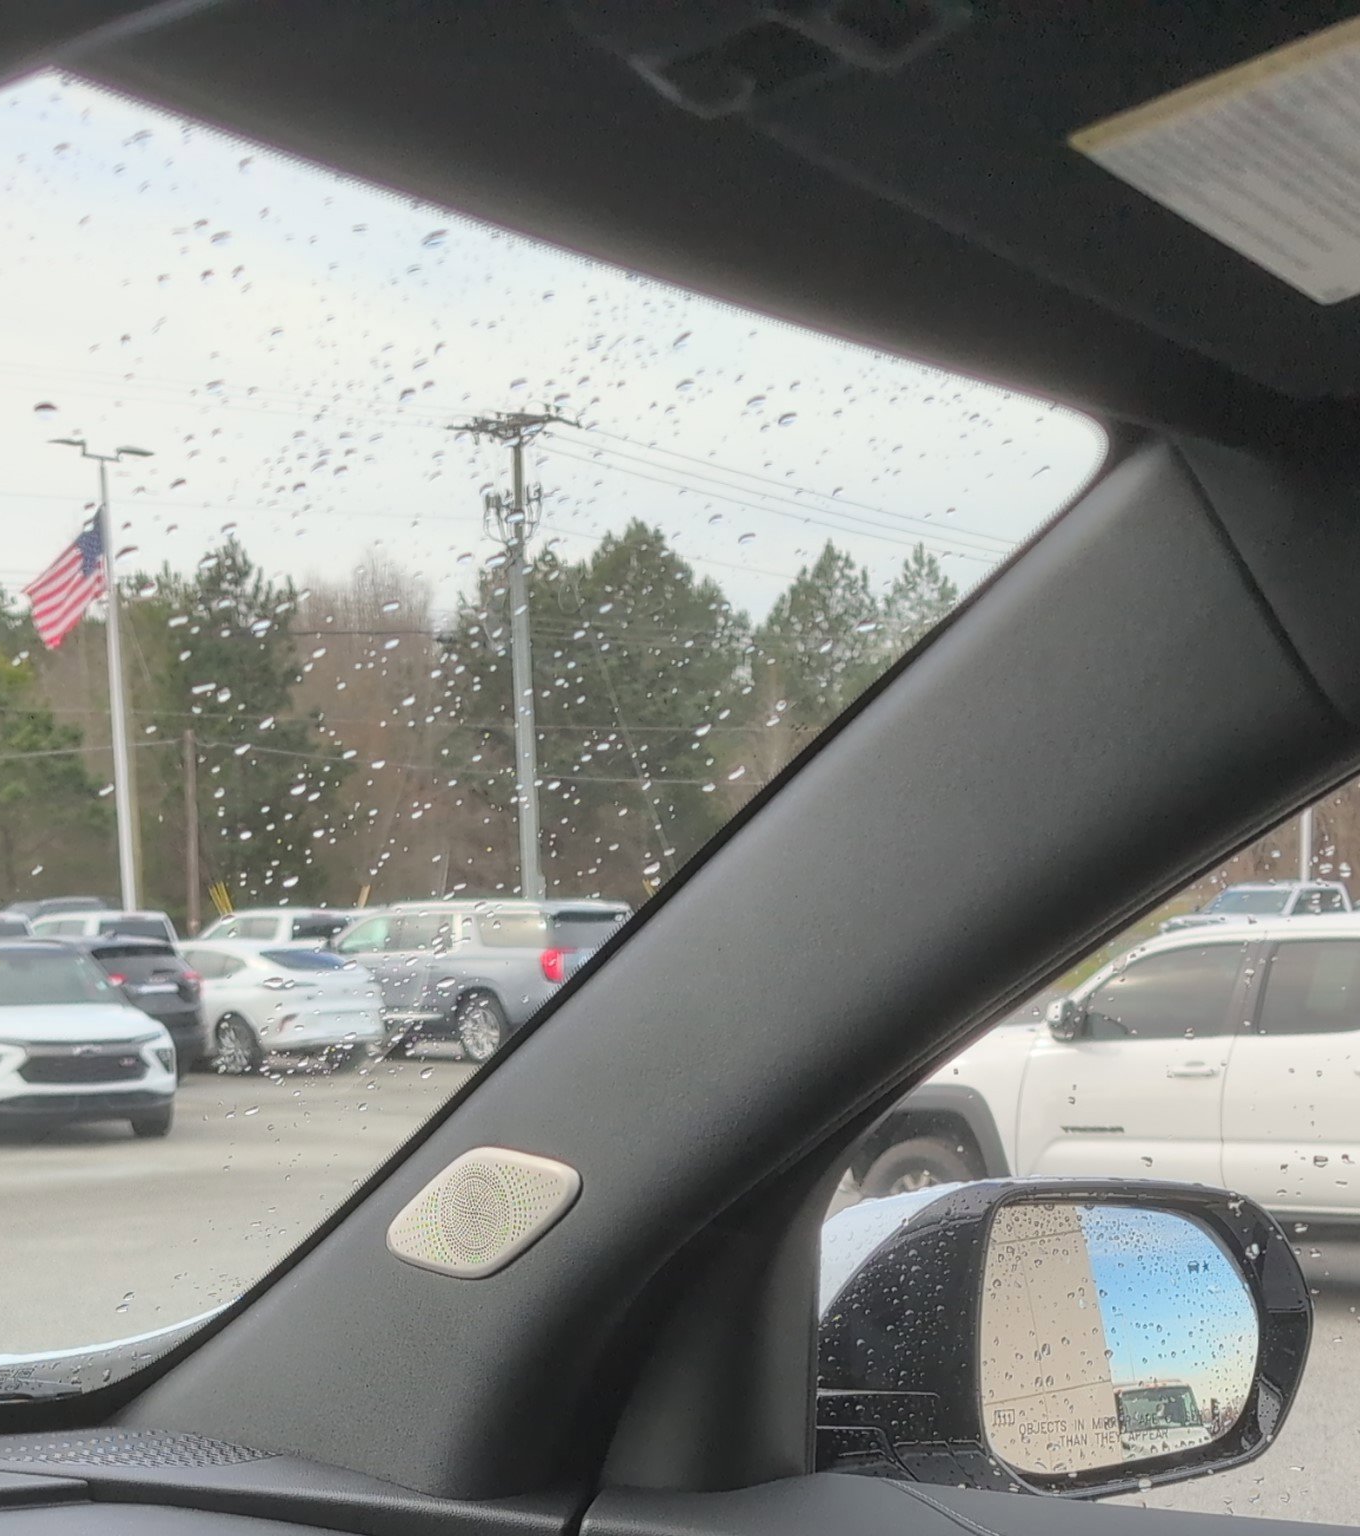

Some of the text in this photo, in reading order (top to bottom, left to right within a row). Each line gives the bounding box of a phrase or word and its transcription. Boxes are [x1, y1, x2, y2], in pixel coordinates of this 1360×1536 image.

[1019, 1420, 1067, 1435] OBJECTS
[1075, 1418, 1085, 1432] IN
[1060, 1428, 1169, 1448] THAN THEY APPEAR
